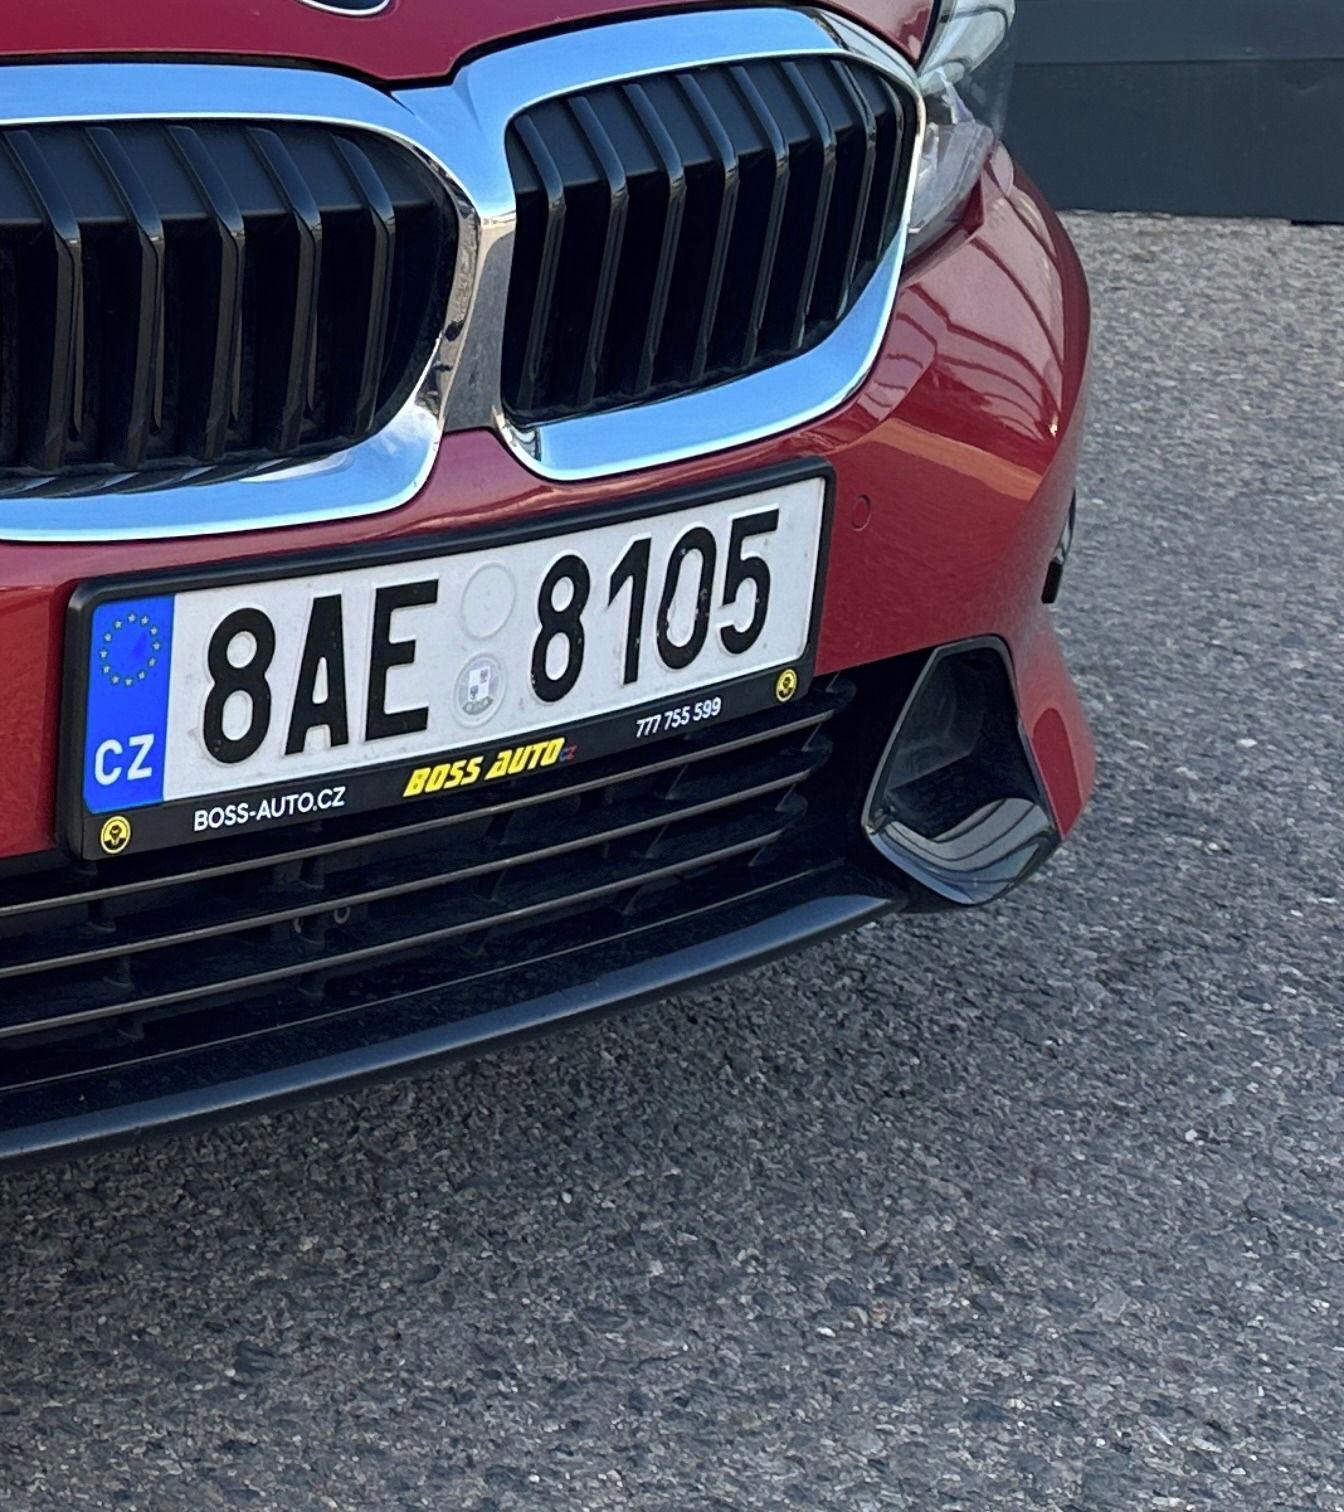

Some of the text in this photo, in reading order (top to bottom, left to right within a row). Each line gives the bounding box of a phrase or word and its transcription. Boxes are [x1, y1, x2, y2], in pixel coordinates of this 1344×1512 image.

[203, 508, 780, 764] 8AE 8105
[635, 696, 722, 738] 777 755 599
[94, 733, 155, 786] CZ
[402, 755, 485, 798] BOSS
[483, 737, 566, 781] AUTO
[193, 786, 347, 832] BOSS-AUTO.CZ
